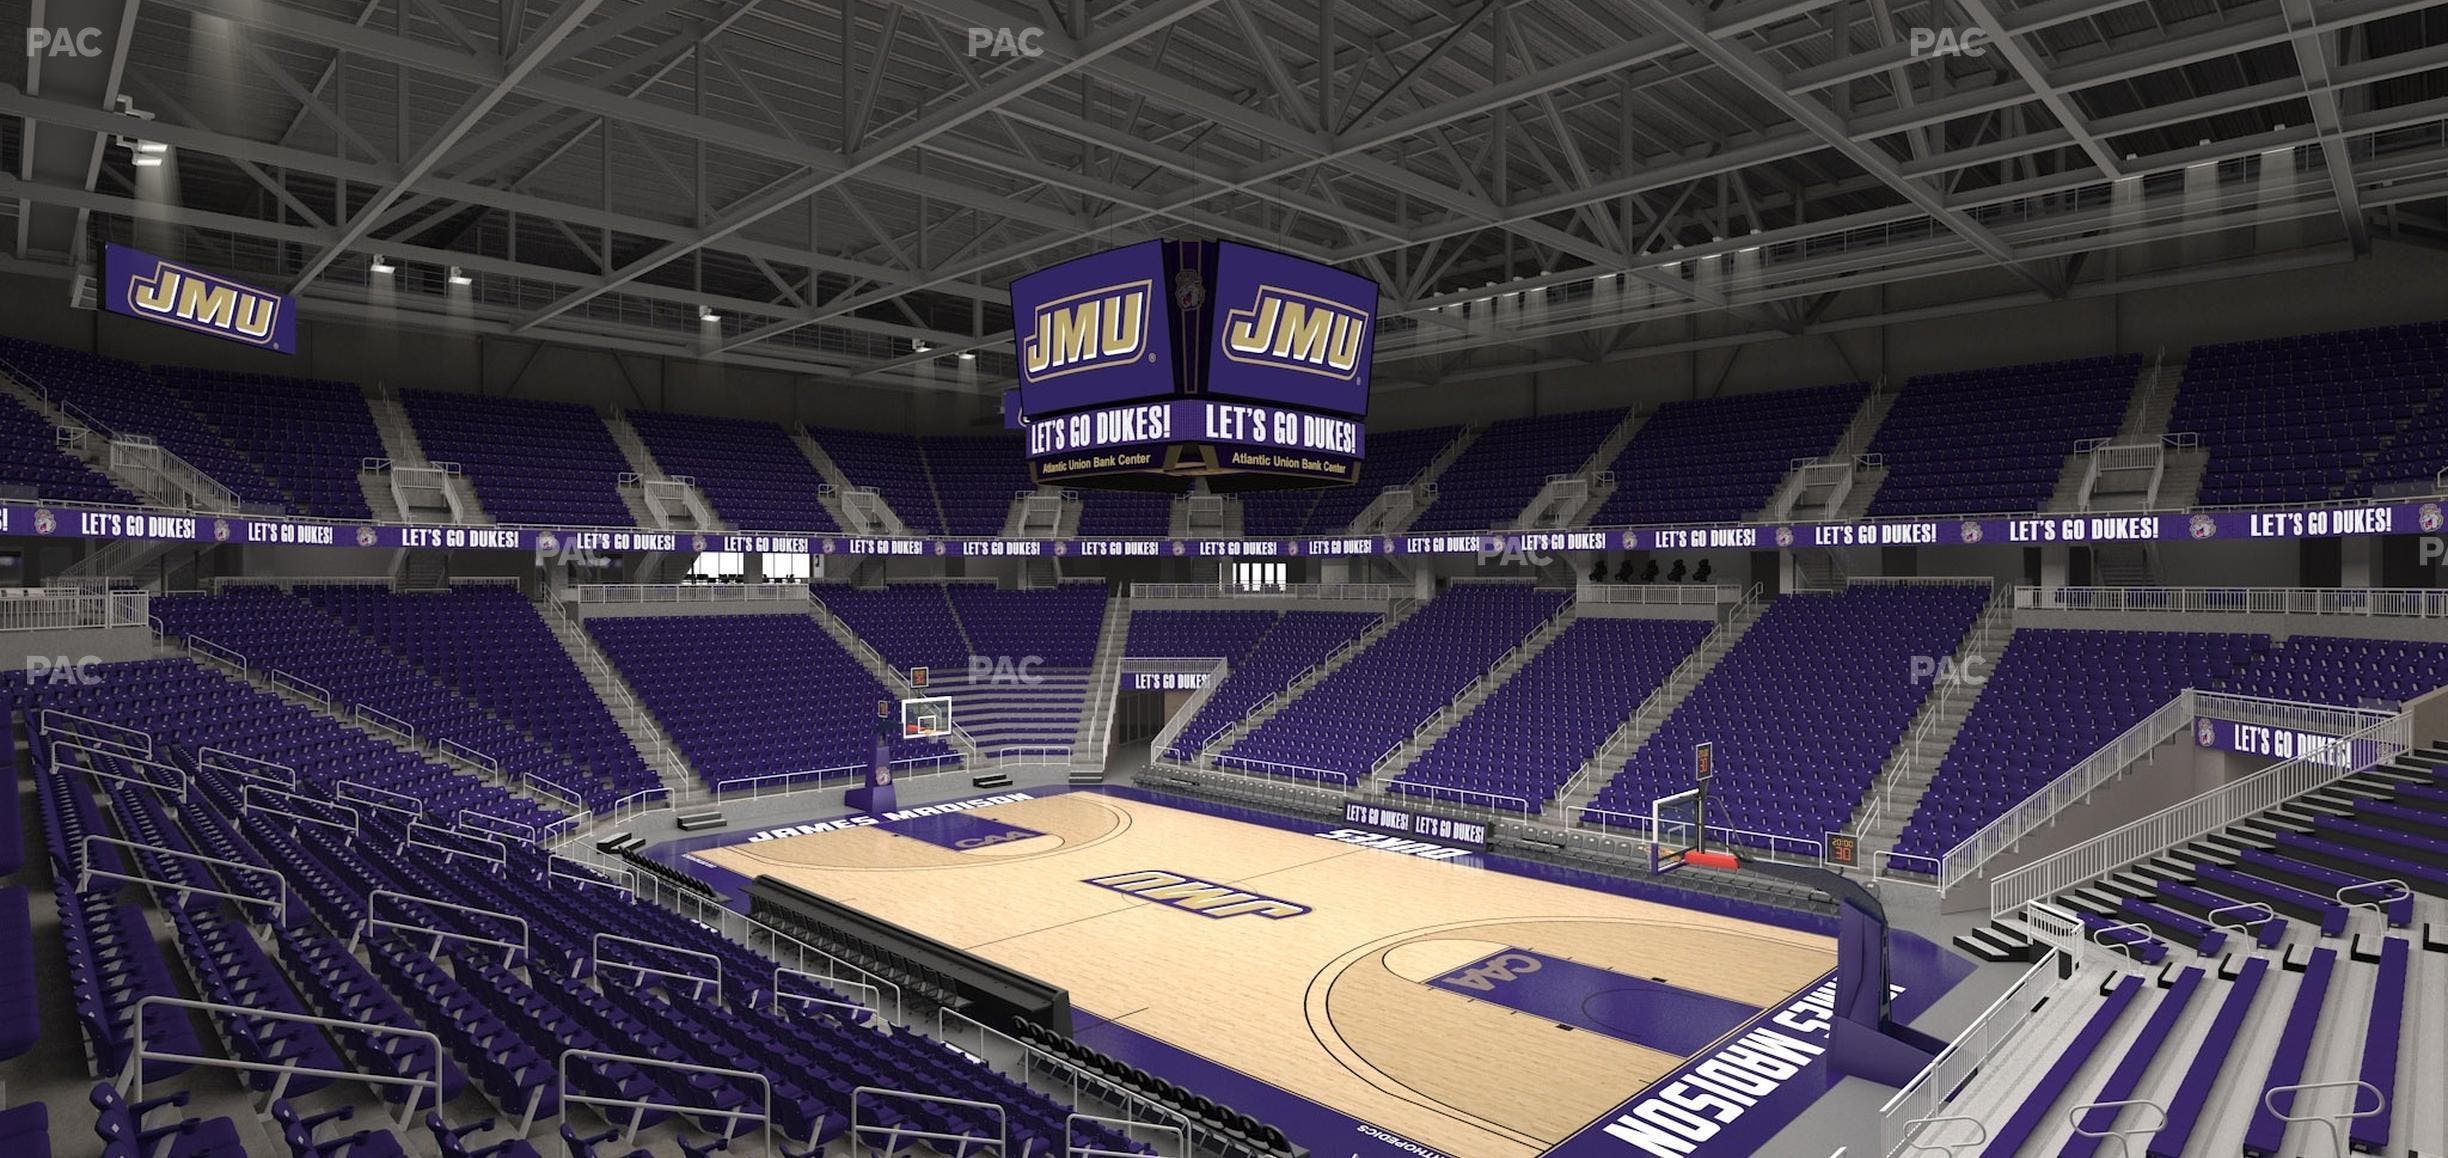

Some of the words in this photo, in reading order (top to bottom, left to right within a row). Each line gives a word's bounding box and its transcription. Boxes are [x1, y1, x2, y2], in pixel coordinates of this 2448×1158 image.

[135, 271, 274, 337] JMU
[1027, 291, 1143, 373] JMU
[1230, 297, 1364, 372] JMU
[1031, 418, 1065, 454] LET'S
[1069, 414, 1089, 448] GO
[1096, 404, 1171, 442] DUKES!
[1206, 403, 1267, 442] LET'S
[1275, 412, 1298, 445] GO
[1303, 416, 1356, 454] DUKES!
[1042, 460, 1068, 474] Atlantic
[1068, 458, 1092, 470] Union
[1093, 455, 1117, 468] Bank
[1118, 453, 1151, 465] Center
[1231, 452, 1271, 466] Atlantic
[1273, 455, 1300, 469] Union
[1301, 458, 1322, 471] Bank
[1323, 461, 1346, 473] Center
[82, 513, 121, 536] LET'S
[126, 515, 144, 537] GO
[149, 517, 195, 539] DUKES!
[248, 522, 278, 542] LET'S
[280, 524, 294, 543] GO
[297, 525, 333, 545] DUKES!
[2010, 520, 2056, 541] LET'S
[2062, 520, 2085, 540] GO
[2091, 517, 2159, 540] DUKES!
[2250, 513, 2303, 537] LET'S
[2308, 512, 2328, 535] GO
[2333, 508, 2392, 534] DUKES!
[401, 528, 443, 547] LET'S
[446, 529, 464, 547] GO
[469, 530, 519, 548] DUKES!
[576, 532, 611, 549] LET'S
[613, 533, 630, 550] GO
[633, 533, 676, 551] DUKES!
[724, 536, 753, 551] LET'S
[756, 537, 770, 552] GO
[772, 538, 808, 553] DUKES!
[1407, 538, 1431, 553] LET'S
[1432, 538, 1445, 552] GO
[1446, 537, 1480, 552] DUKES!
[1521, 535, 1549, 551] LET'S
[1550, 534, 1565, 550] GO
[1567, 533, 1606, 550] DUKES!
[1655, 531, 1687, 548] LET'S
[1690, 530, 1707, 547] GO
[1710, 529, 1756, 547] DUKES!
[1815, 526, 1853, 545] LET'S
[1858, 525, 1877, 544] GO
[1882, 523, 1937, 543] DUKES!
[850, 540, 875, 553] LET'S
[877, 541, 889, 553] GO
[891, 541, 922, 555] DUKES!
[963, 542, 989, 555] LET'S
[991, 542, 1004, 555] GO
[1006, 542, 1040, 555] DUKES!
[1081, 542, 1107, 555] LET'S
[1109, 542, 1122, 555] GO
[1124, 542, 1158, 555] DUKES!
[1200, 542, 1226, 555] LET'S
[1227, 542, 1241, 555] GO
[1243, 542, 1277, 555] DUKES!
[1309, 541, 1330, 554] LET'S
[1331, 541, 1342, 554] GO
[1343, 540, 1372, 553] DUKES!
[1135, 674, 1160, 689] LET'S
[1162, 674, 1175, 689] GO
[2234, 723, 2270, 755] LET'S
[2274, 730, 2292, 759] GO
[748, 815, 879, 843] JAMES
[885, 792, 1036, 821] MADISON
[1346, 803, 1368, 823] LET'S
[1368, 807, 1379, 826] GO
[1380, 809, 1410, 831] DUKES!
[955, 830, 1033, 850] CAA
[1415, 815, 1439, 836] LET'S
[1440, 820, 1452, 839] GO
[1453, 822, 1485, 844] DUKES!
[1834, 846, 1851, 861] 30
[1088, 870, 1306, 919] JMU
[1442, 954, 1542, 992] CAA
[1602, 1026, 1826, 1158] MADISON
